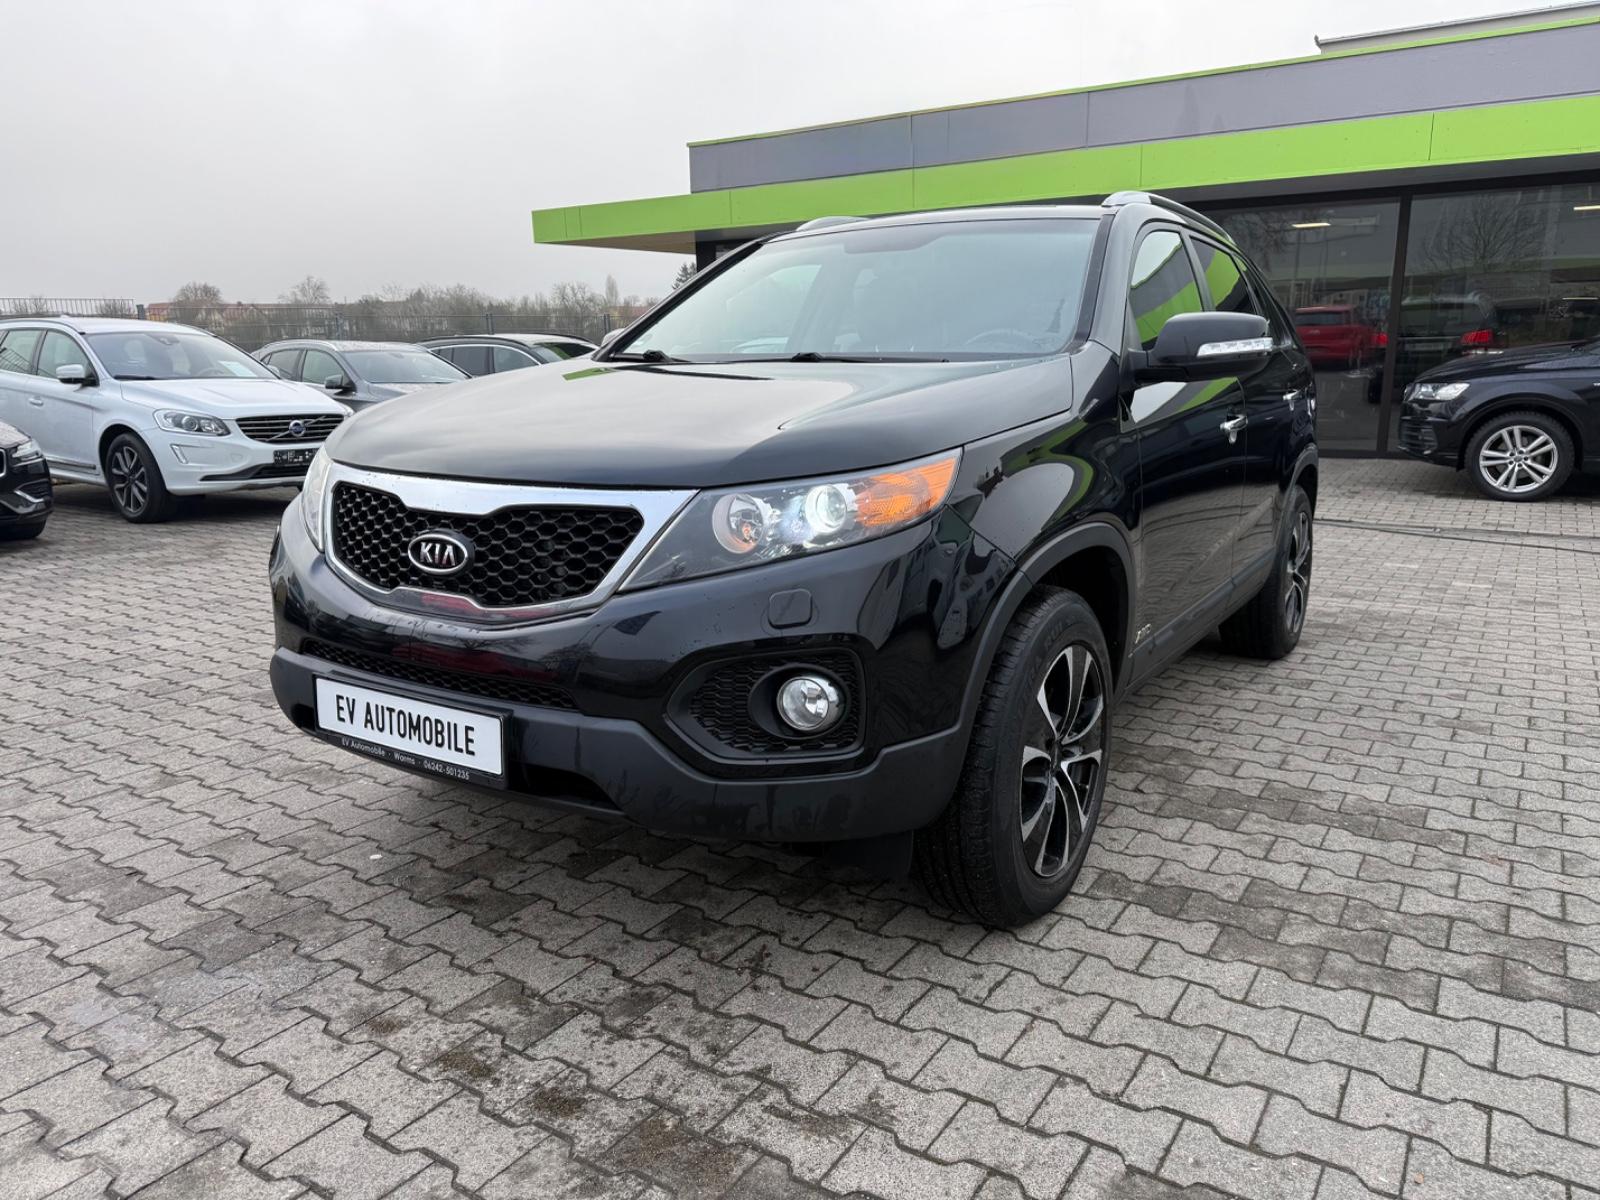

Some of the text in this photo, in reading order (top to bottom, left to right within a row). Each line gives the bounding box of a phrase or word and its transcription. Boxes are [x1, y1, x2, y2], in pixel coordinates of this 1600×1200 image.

[420, 542, 456, 566] KIA
[335, 694, 476, 756] EV AUTOMOBILE
[341, 738, 350, 747] EV
[350, 740, 386, 757] Automobile
[393, 752, 416, 765] Worms
